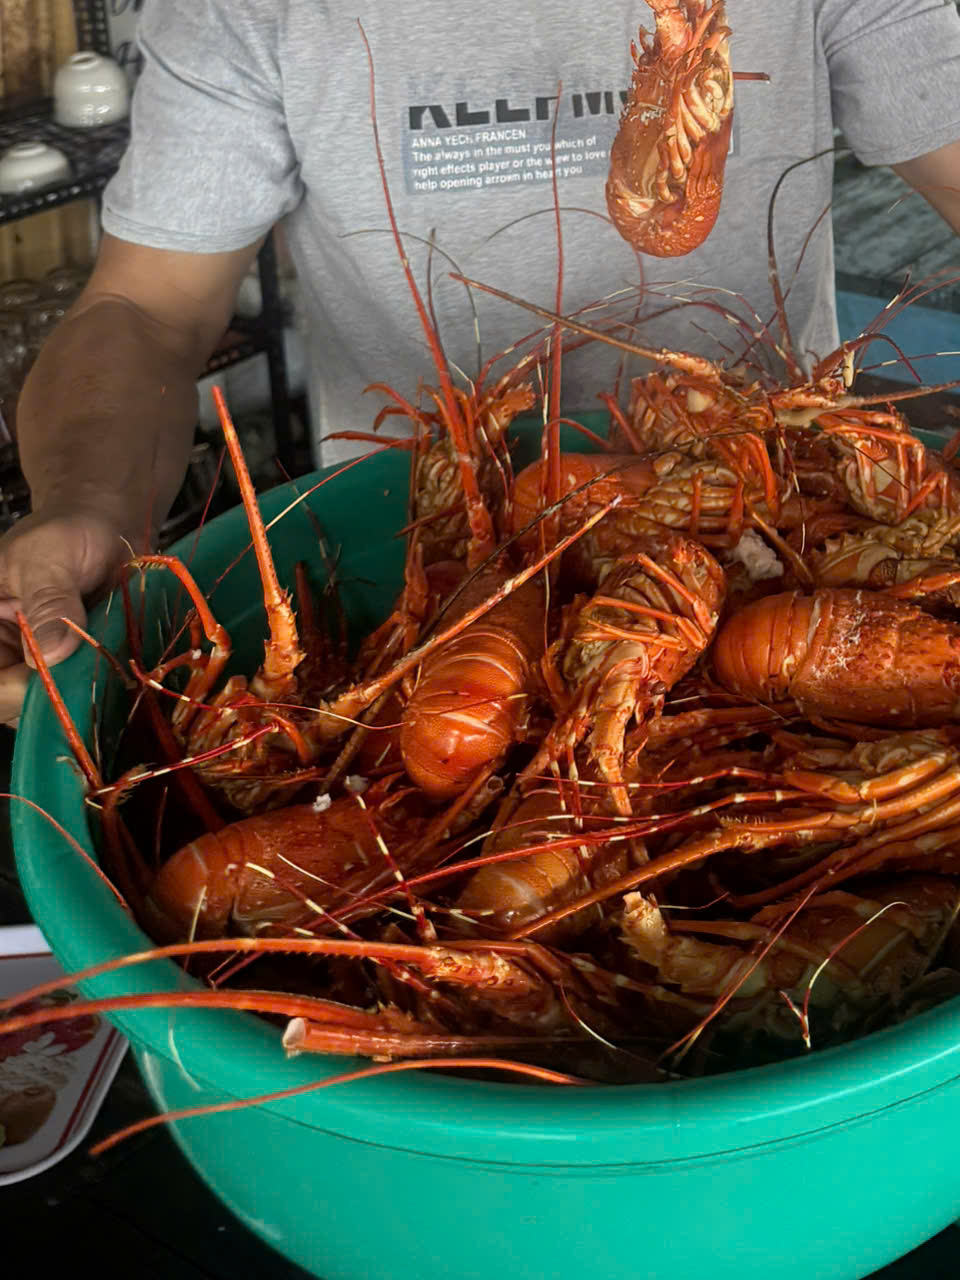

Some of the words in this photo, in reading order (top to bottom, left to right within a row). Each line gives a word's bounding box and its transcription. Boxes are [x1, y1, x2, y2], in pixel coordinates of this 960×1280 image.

[411, 136, 442, 148] ANNA
[475, 129, 527, 143] FRANCEN
[411, 151, 433, 162] The
[434, 149, 471, 162] always
[473, 148, 484, 158] in
[485, 146, 503, 157] the
[503, 143, 531, 154] must
[532, 143, 552, 155] you
[554, 136, 585, 150] which
[586, 135, 597, 147] of
[413, 166, 438, 179] right
[439, 164, 476, 176] effects
[479, 160, 510, 174] player
[526, 156, 543, 168] the
[571, 151, 583, 162] to
[584, 148, 607, 161] love
[415, 179, 438, 191] help
[440, 177, 482, 189] opening
[522, 171, 534, 182] in
[563, 164, 583, 178] you
